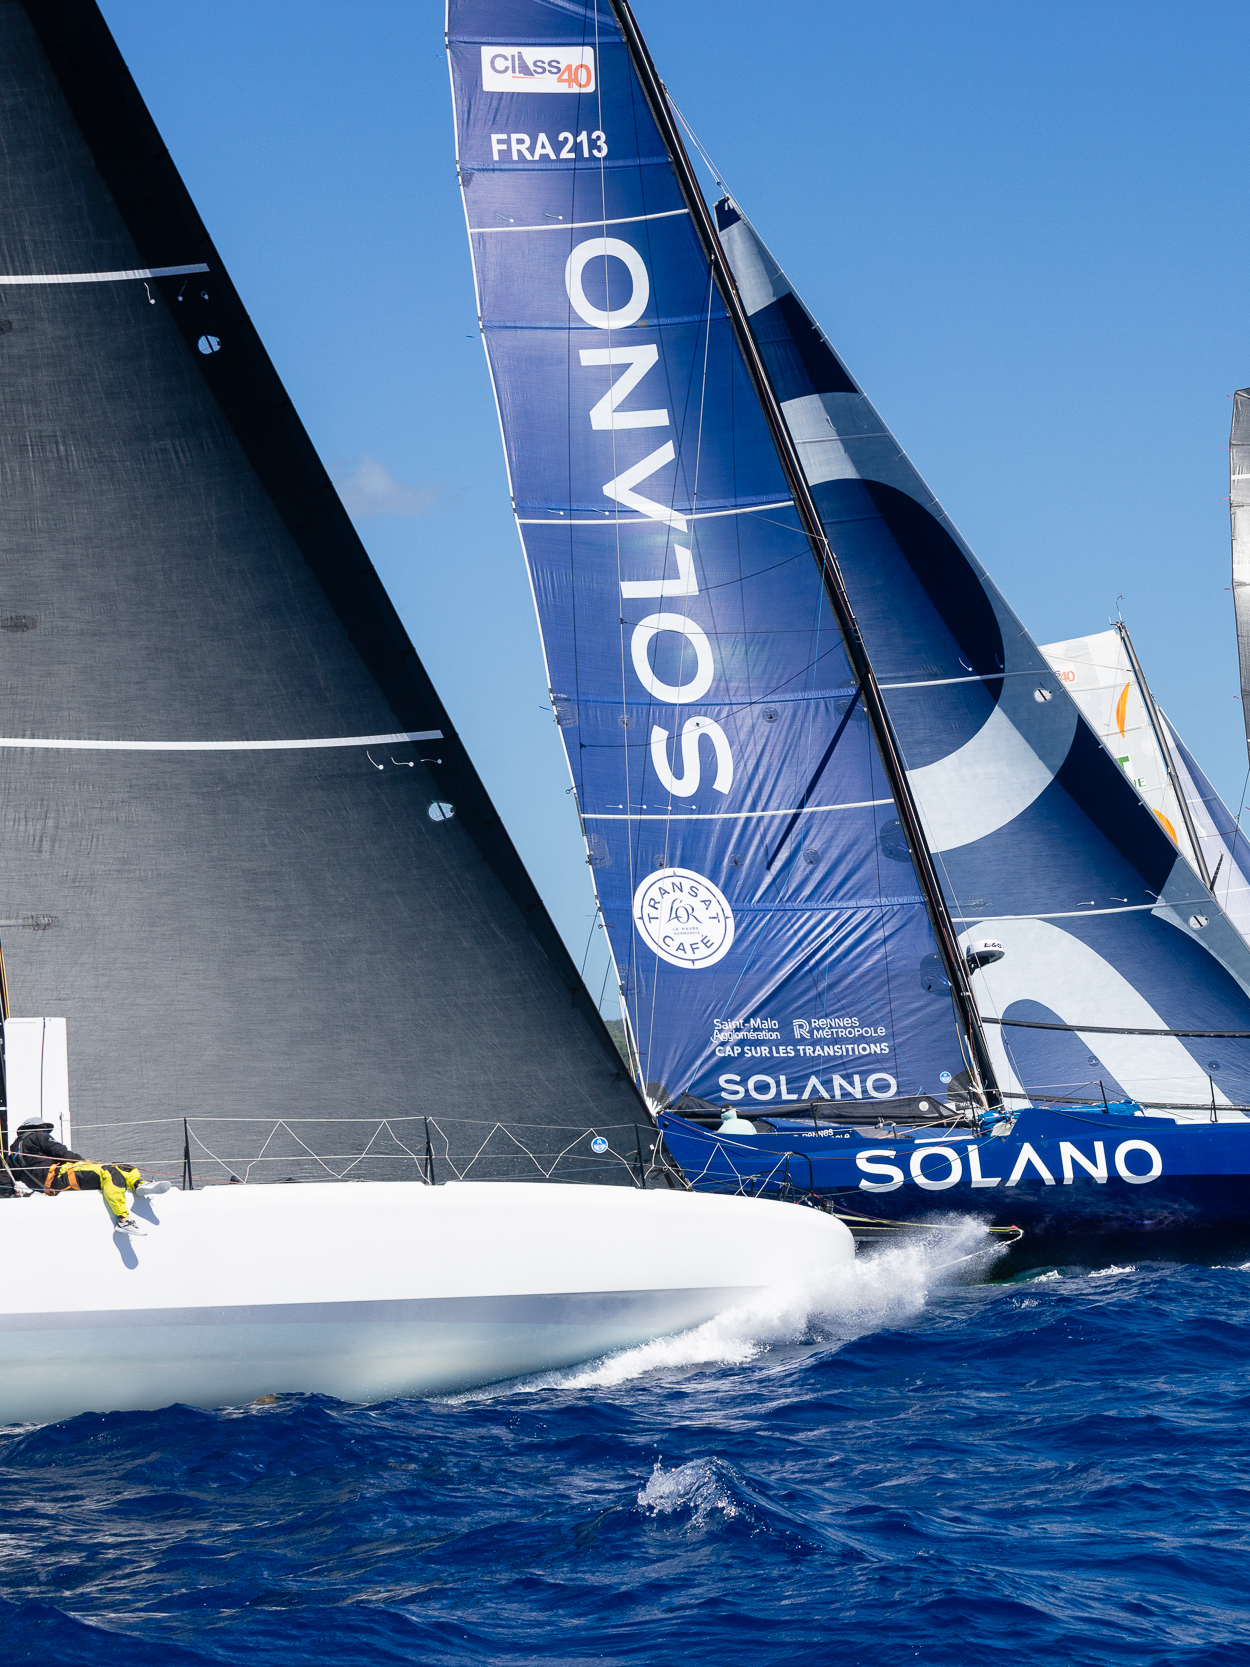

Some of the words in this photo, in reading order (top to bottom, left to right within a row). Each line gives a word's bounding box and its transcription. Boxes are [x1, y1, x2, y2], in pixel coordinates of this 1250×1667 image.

[564, 237, 733, 798] SOLANO
[647, 881, 721, 924] TRANSAT
[662, 934, 715, 955] CAFÉ
[713, 1017, 779, 1030] Saint-Malo
[710, 1029, 781, 1043] Agglomération
[715, 1045, 741, 1057] CAP
[744, 1045, 771, 1057] SUR
[772, 1045, 795, 1057] LES
[797, 1043, 890, 1057] TRANSITIONS
[718, 1073, 898, 1100] SOLANO
[855, 1139, 1163, 1193] SOLANO
